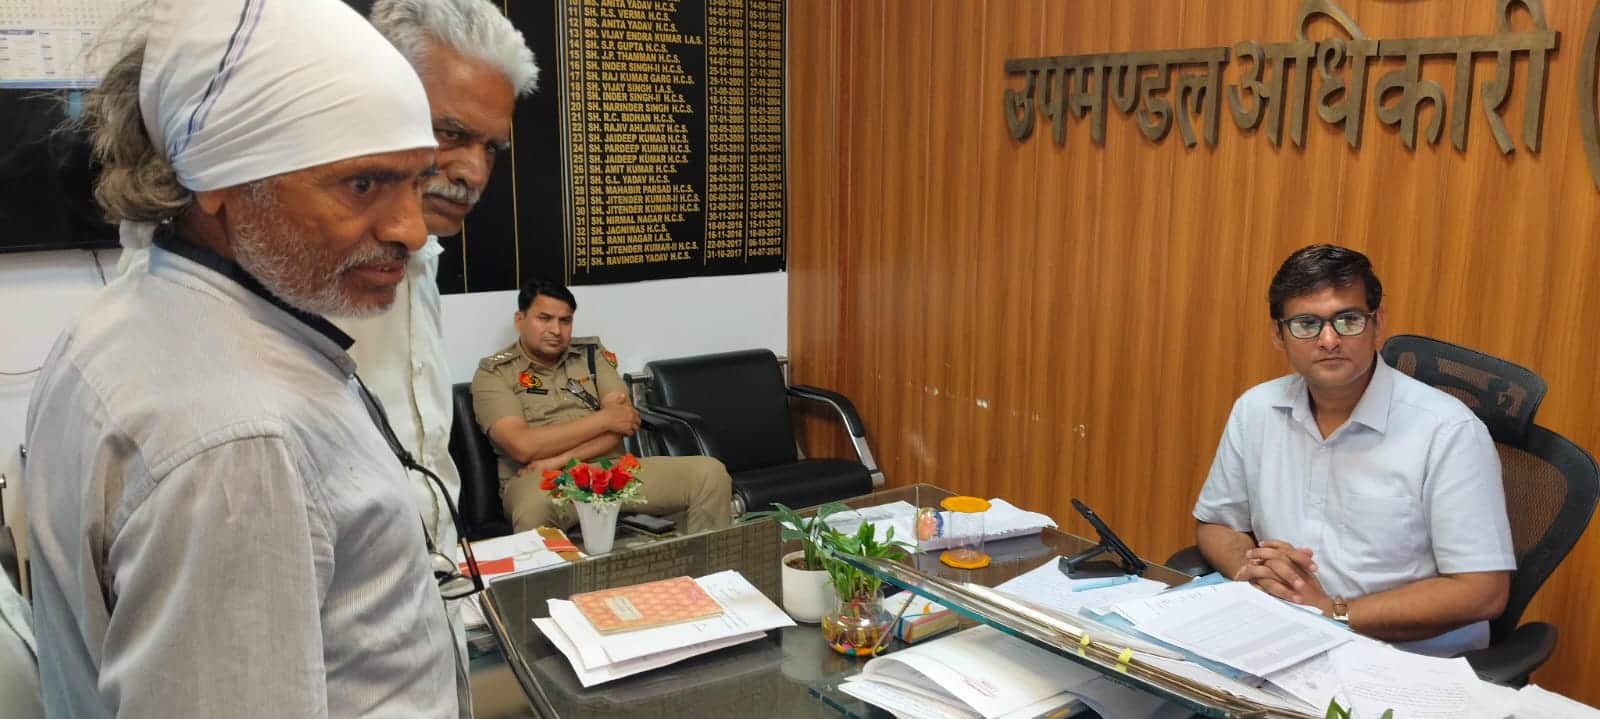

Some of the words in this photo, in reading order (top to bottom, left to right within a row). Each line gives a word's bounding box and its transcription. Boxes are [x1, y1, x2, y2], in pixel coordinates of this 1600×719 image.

[569, 7, 577, 16] 11
[584, 7, 599, 17] SH.
[619, 9, 645, 20] VERMA
[569, 18, 578, 27] 12
[584, 18, 599, 28] MS.
[601, 19, 626, 29] ANITA
[628, 20, 652, 31] YADAV
[570, 29, 579, 38] 13
[585, 29, 599, 39] SH.
[601, 29, 625, 40] VIJAY
[655, 32, 682, 43] KUMAR
[570, 40, 579, 48] 14
[585, 40, 599, 49] SH.
[617, 41, 643, 51] GUPTA
[570, 50, 579, 59] 15
[585, 50, 599, 60] SH.
[570, 61, 579, 70] 16
[586, 61, 600, 71] SH.
[602, 62, 627, 71] INDER
[570, 71, 580, 80] 17
[586, 72, 600, 81] SH.
[602, 72, 619, 81] RAJ
[621, 72, 648, 82] KUMAR
[650, 73, 672, 83] GARG
[1004, 46, 1231, 150] उपमण्डल
[1228, 0, 1561, 155] अधिकारी
[586, 82, 600, 91] SH.
[602, 82, 625, 92] VIJAY
[627, 83, 651, 93] SINGH
[571, 92, 580, 101] 19
[587, 92, 601, 101] SH.
[603, 92, 627, 101] INDER
[571, 102, 581, 111] 20
[587, 102, 601, 111] SH.
[603, 102, 644, 112] NARINDER
[645, 103, 669, 113] SINGH
[571, 112, 581, 122] 21
[588, 112, 602, 122] SH.
[588, 123, 602, 132] SH.
[604, 123, 628, 132] RAJIV
[629, 123, 665, 133] AHLAWAT
[573, 133, 583, 142] 23
[588, 133, 602, 143] SH.
[604, 134, 637, 143] JAIDEEP
[640, 134, 666, 143] KUMAR
[573, 144, 583, 153] 24
[589, 144, 603, 153] SH.
[605, 144, 640, 153] PARDEEP
[642, 144, 669, 153] KUMAR
[589, 154, 603, 164] SH.
[604, 154, 637, 163] JAIDEEP
[640, 155, 666, 163] KUMAR
[589, 165, 603, 174] SH.
[605, 165, 624, 174] AMIT
[626, 165, 654, 173] KUMAR
[574, 175, 584, 184] 27
[590, 175, 604, 185] SH.
[622, 175, 647, 184] YADAV
[590, 186, 604, 195] SH.
[591, 196, 605, 205] SH.
[606, 195, 644, 205] JITENDER
[591, 206, 605, 215] SH.
[606, 205, 644, 215] JITENDER
[576, 217, 586, 226] 31
[591, 216, 605, 225] SH.
[637, 215, 662, 223] NAGAR
[576, 227, 586, 236] 32
[591, 227, 605, 236] SH.
[591, 237, 605, 246] MS.
[627, 234, 653, 244] NAGAR
[576, 247, 586, 256] 34
[591, 247, 605, 256] SH.
[606, 245, 643, 255] JITENDER
[591, 257, 605, 266] SH.
[606, 255, 644, 265] RAVINDER
[645, 253, 669, 263] YADAV
